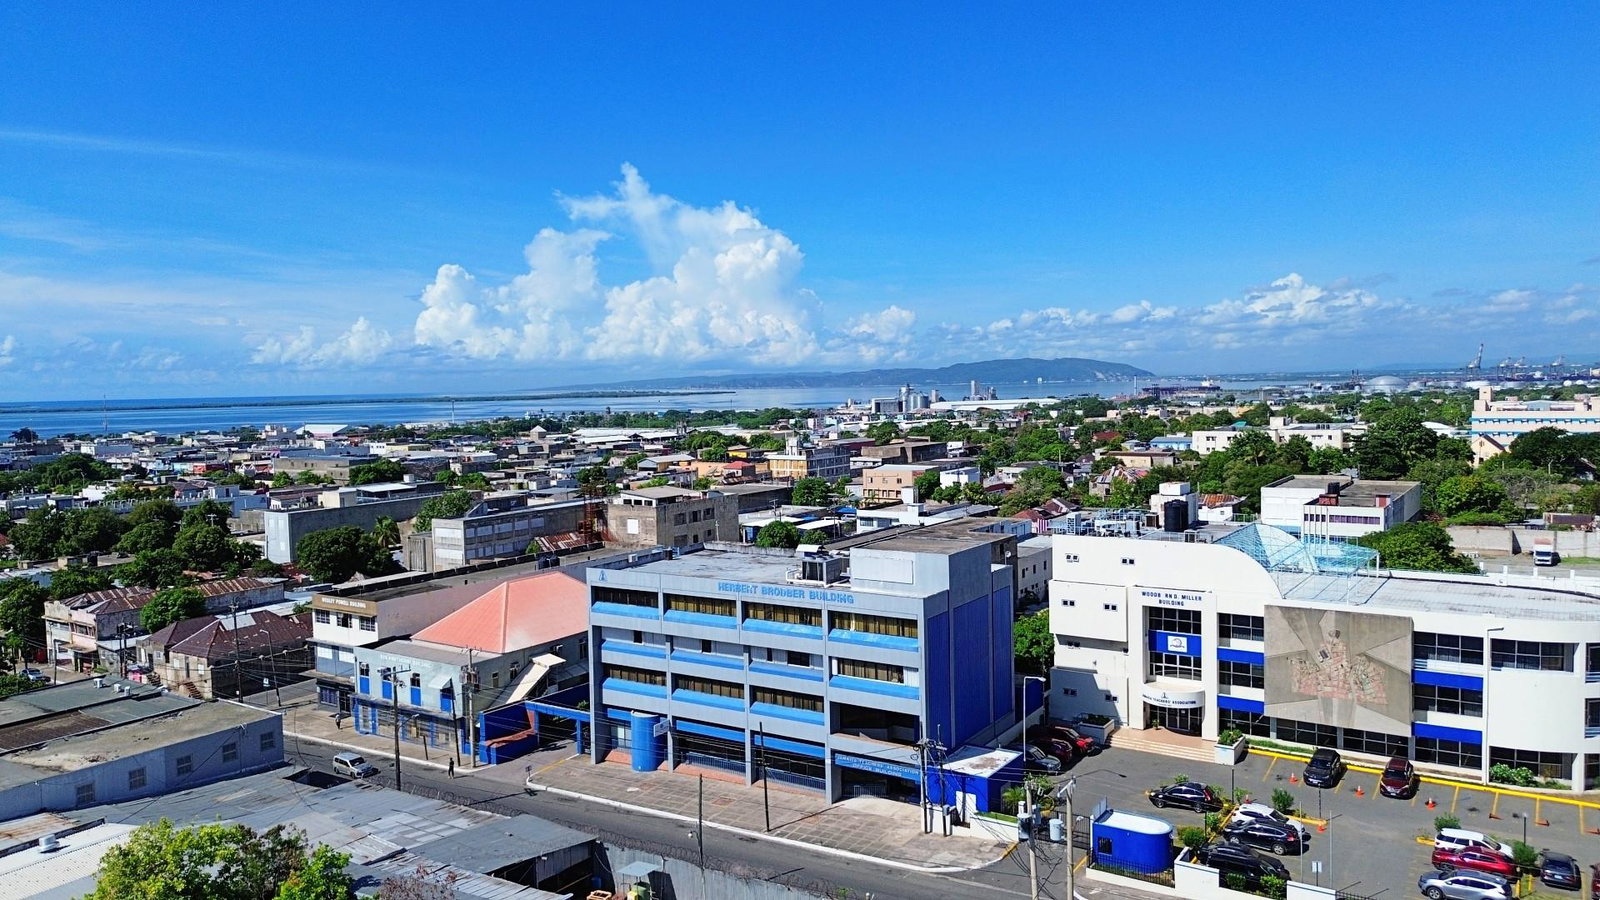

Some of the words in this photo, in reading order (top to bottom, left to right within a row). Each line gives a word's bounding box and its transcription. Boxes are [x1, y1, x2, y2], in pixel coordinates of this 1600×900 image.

[718, 583, 759, 594] HERBERT
[809, 591, 854, 603] BUILDING
[1181, 594, 1202, 602] MILLER
[876, 767, 902, 777] BUILDING
